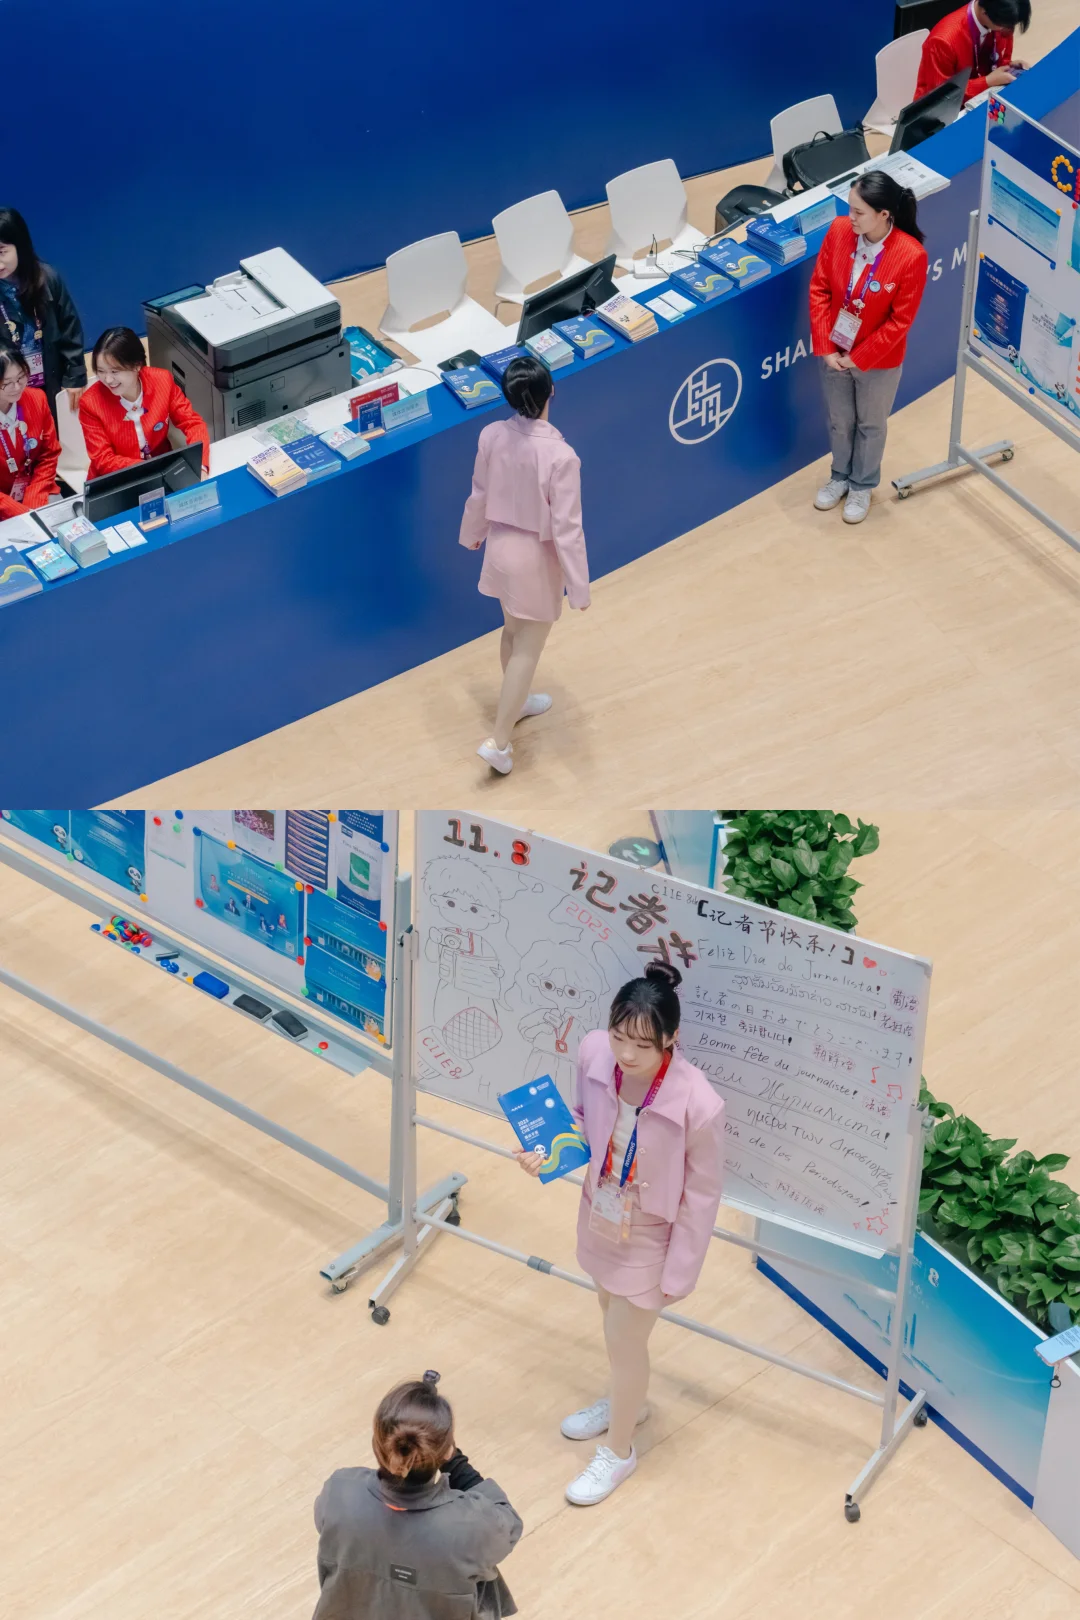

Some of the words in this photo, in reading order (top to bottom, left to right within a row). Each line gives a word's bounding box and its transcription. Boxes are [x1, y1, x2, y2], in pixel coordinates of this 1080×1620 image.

[443, 818, 531, 866] 11.8
[565, 901, 612, 941] 2025
[697, 938, 736, 961] Feliz
[777, 955, 793, 972] do
[699, 1032, 737, 1054] Bonne
[743, 1045, 770, 1064] fête
[774, 1059, 790, 1072] du
[794, 1066, 858, 1100] journaliste!
[748, 1136, 766, 1149] de
[773, 1145, 792, 1162] los
